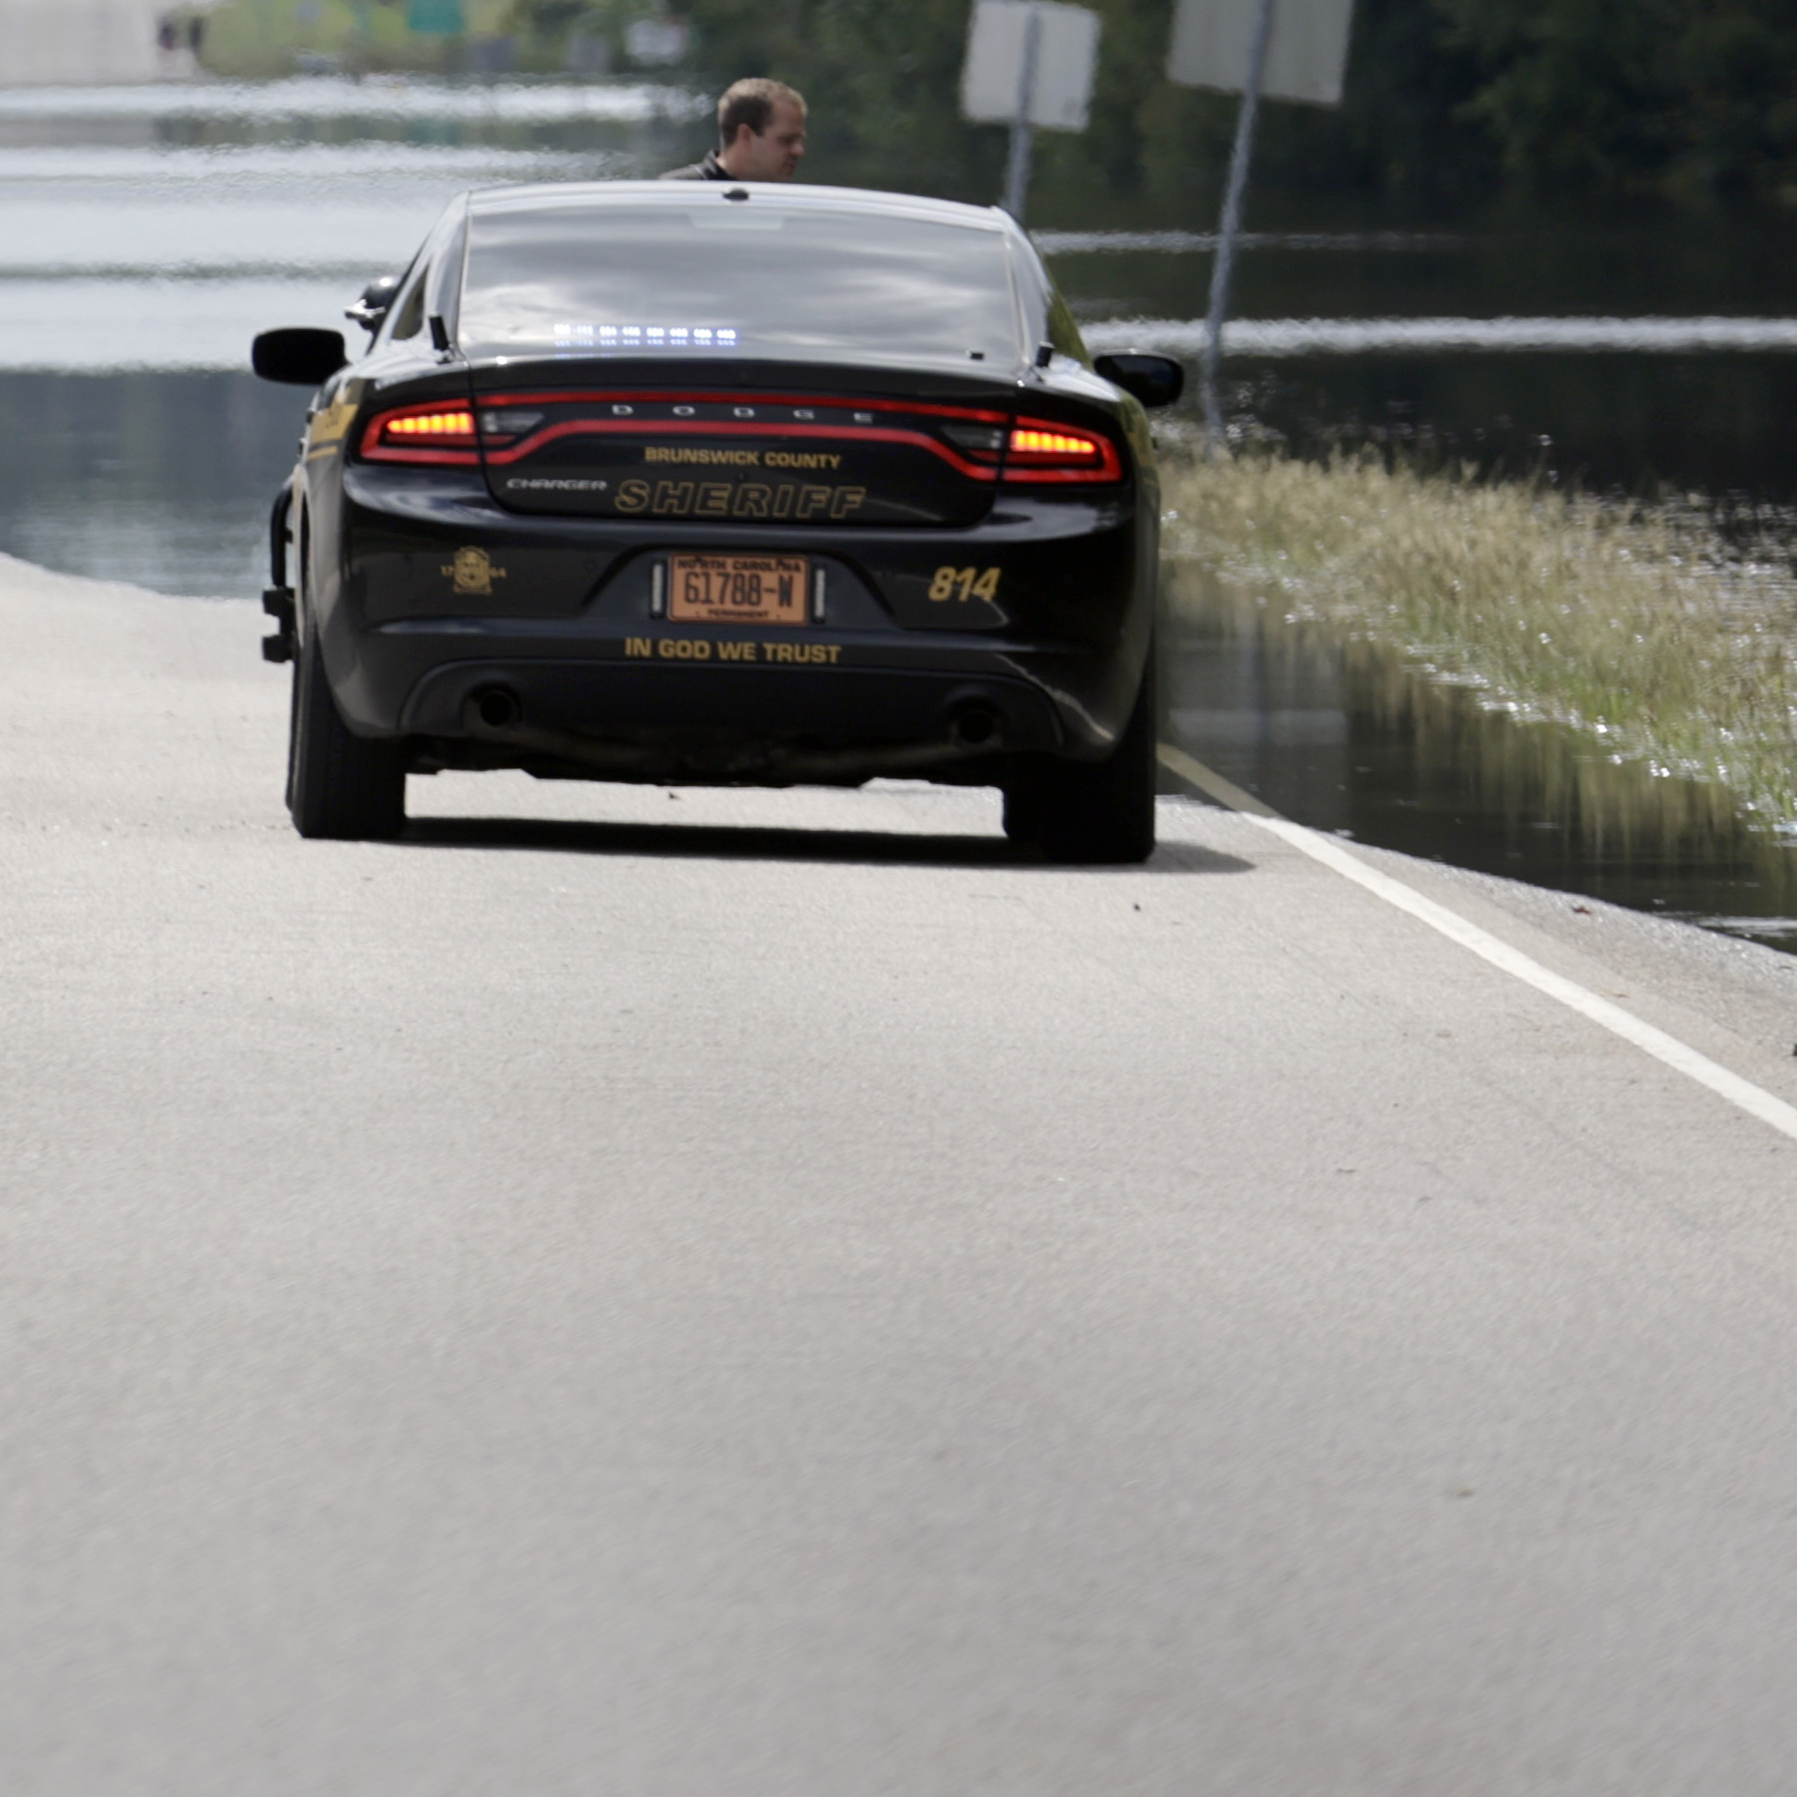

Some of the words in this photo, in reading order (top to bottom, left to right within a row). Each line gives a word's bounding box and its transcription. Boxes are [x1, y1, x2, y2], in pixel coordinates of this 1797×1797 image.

[611, 404, 873, 423] DODGE
[644, 446, 759, 466] BRUNSWICK
[765, 452, 841, 469] COUNTY
[614, 479, 867, 519] SHERIFF
[677, 559, 726, 570] NORTH
[928, 566, 1002, 602] 814
[625, 637, 652, 658] IN
[658, 638, 710, 660] GOD
[717, 641, 757, 661] WE
[763, 643, 842, 664] TRUST
